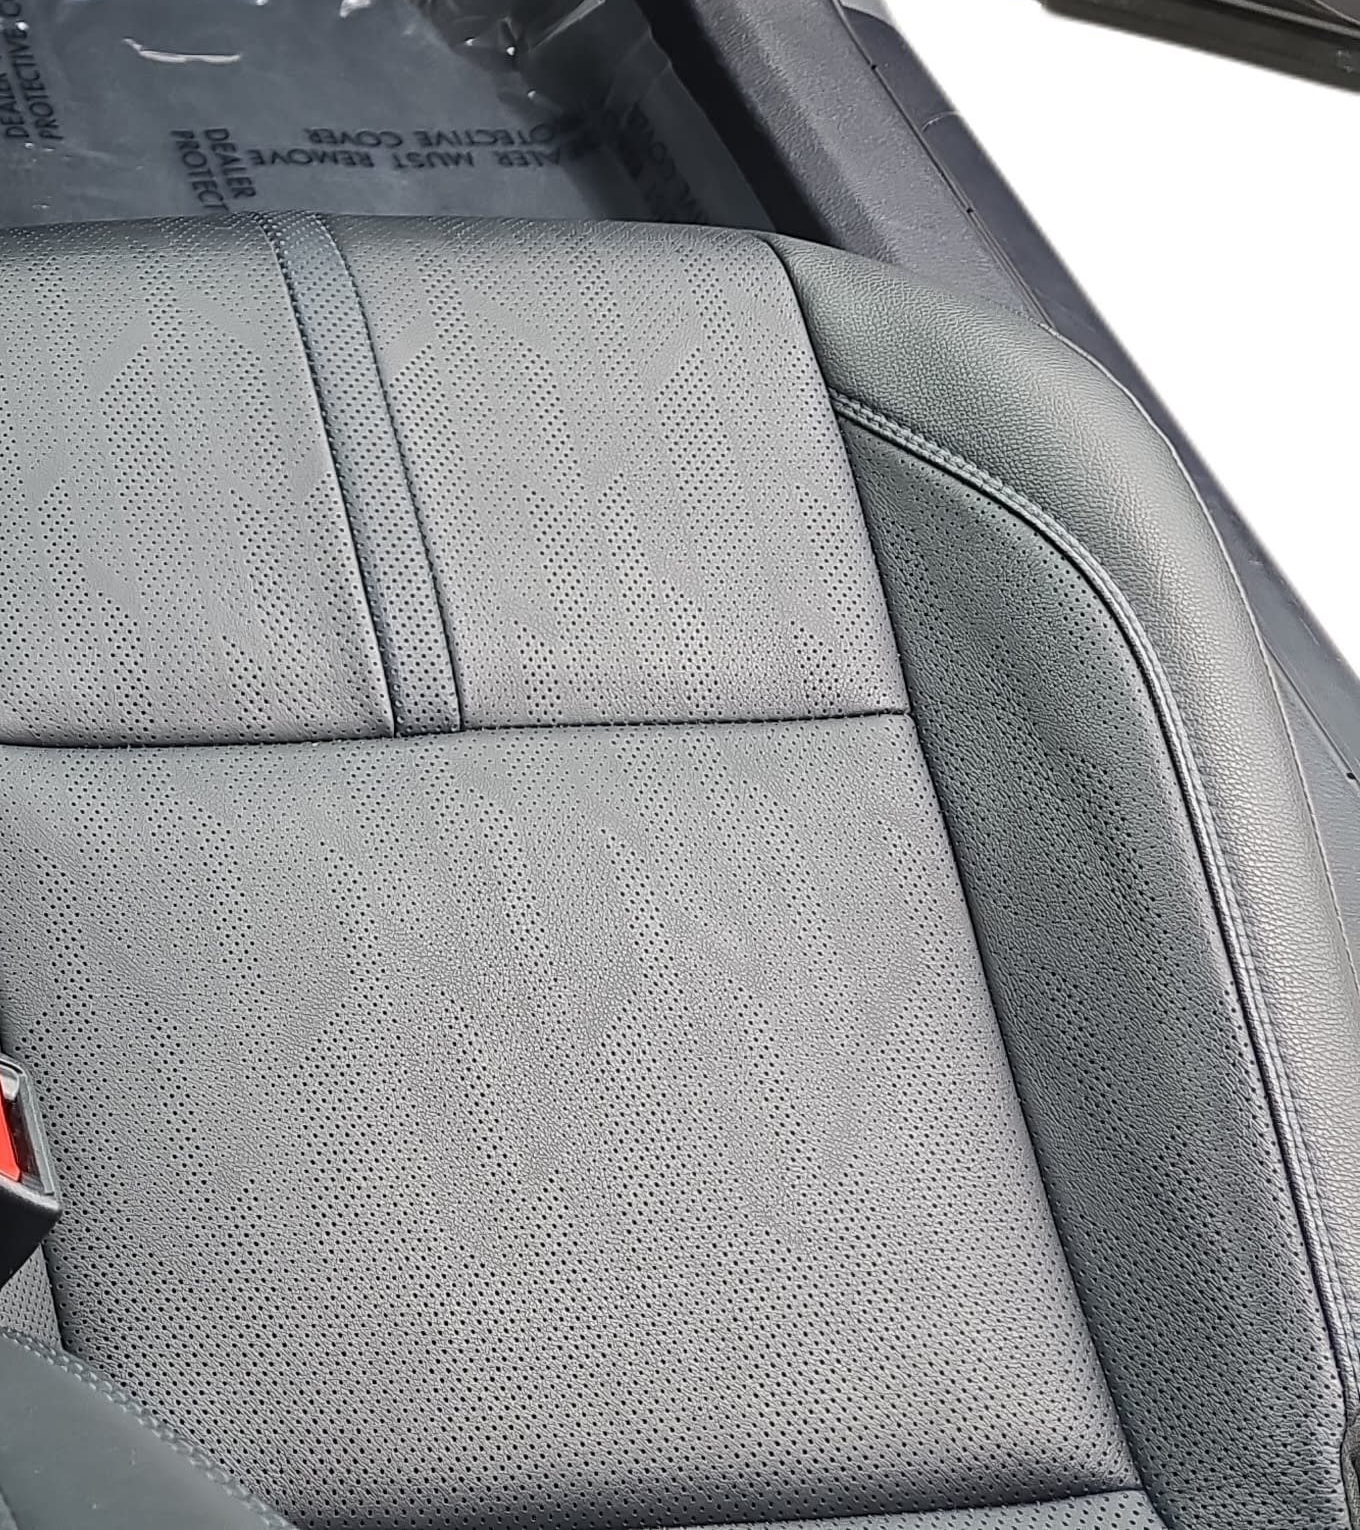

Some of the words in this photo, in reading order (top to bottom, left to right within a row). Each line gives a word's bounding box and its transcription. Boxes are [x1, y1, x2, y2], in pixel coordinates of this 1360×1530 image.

[304, 127, 402, 148] COVER
[203, 127, 256, 200] DEALER
[248, 148, 376, 168] REMOVE
[392, 150, 475, 170] MUST
[171, 130, 230, 212] PROTECT
